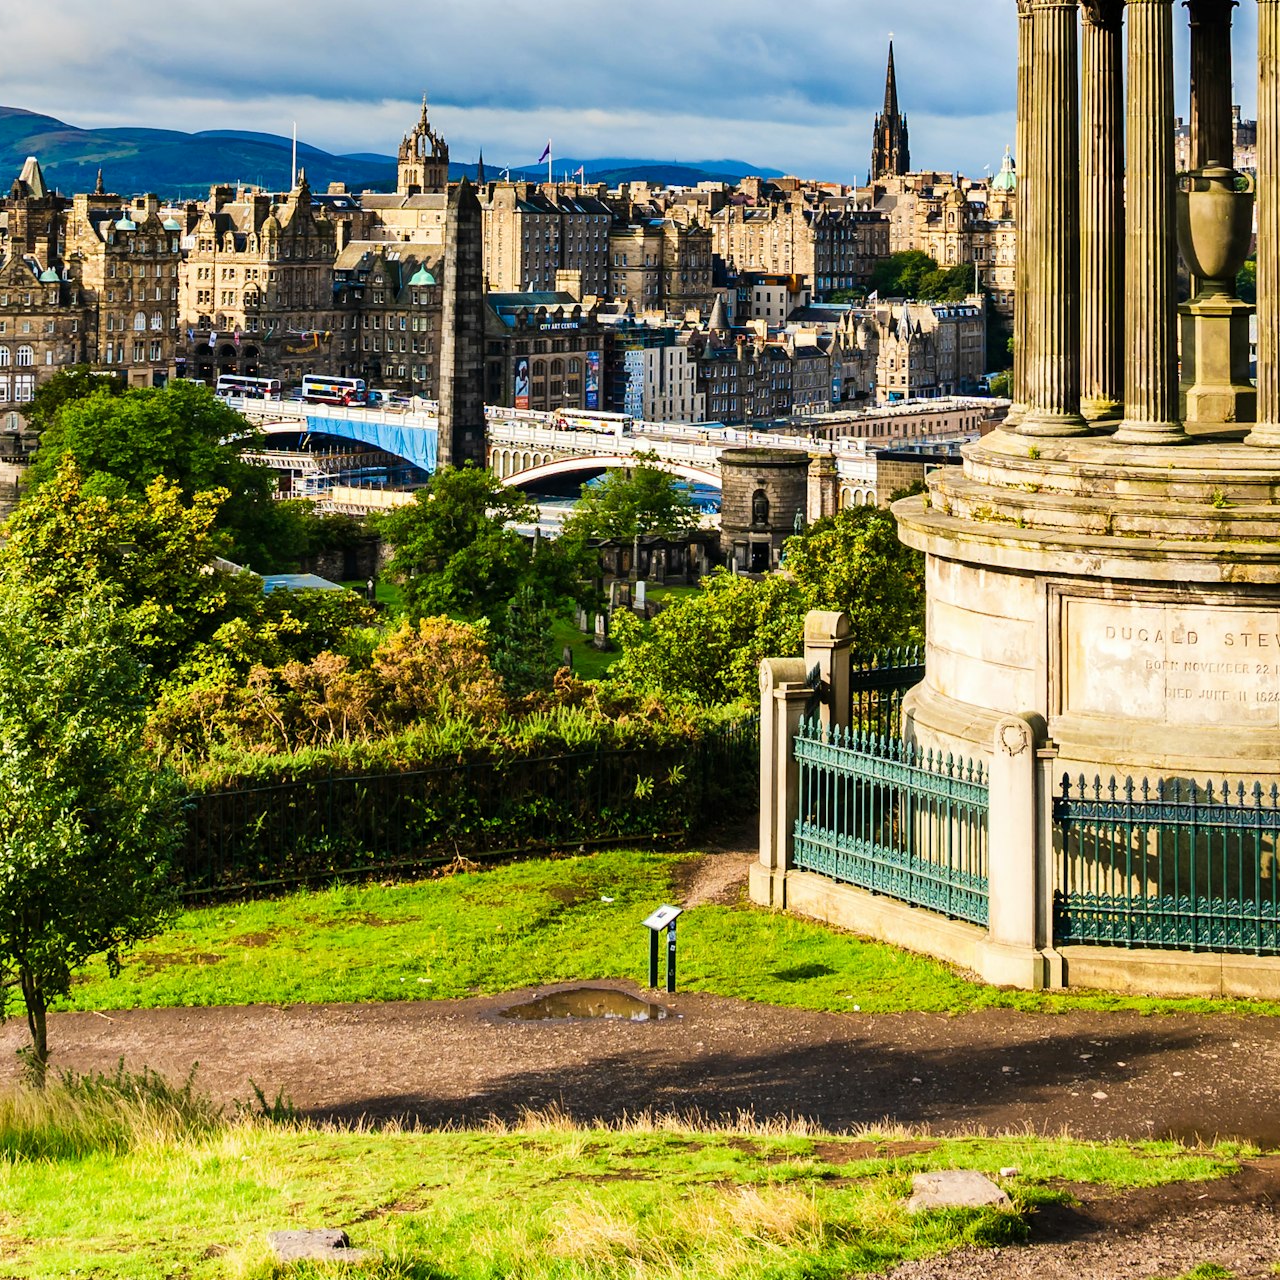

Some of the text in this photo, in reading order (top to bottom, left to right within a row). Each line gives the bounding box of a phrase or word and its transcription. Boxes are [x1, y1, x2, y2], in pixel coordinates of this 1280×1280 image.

[1105, 625, 1199, 645] DUGALD
[1145, 659, 1179, 672] BORN
[1184, 661, 1251, 675] NOVEMBER
[1255, 664, 1271, 675] 22
[1165, 687, 1193, 699] DIED
[1198, 689, 1231, 702] JUNE
[1256, 691, 1280, 703] 1828
